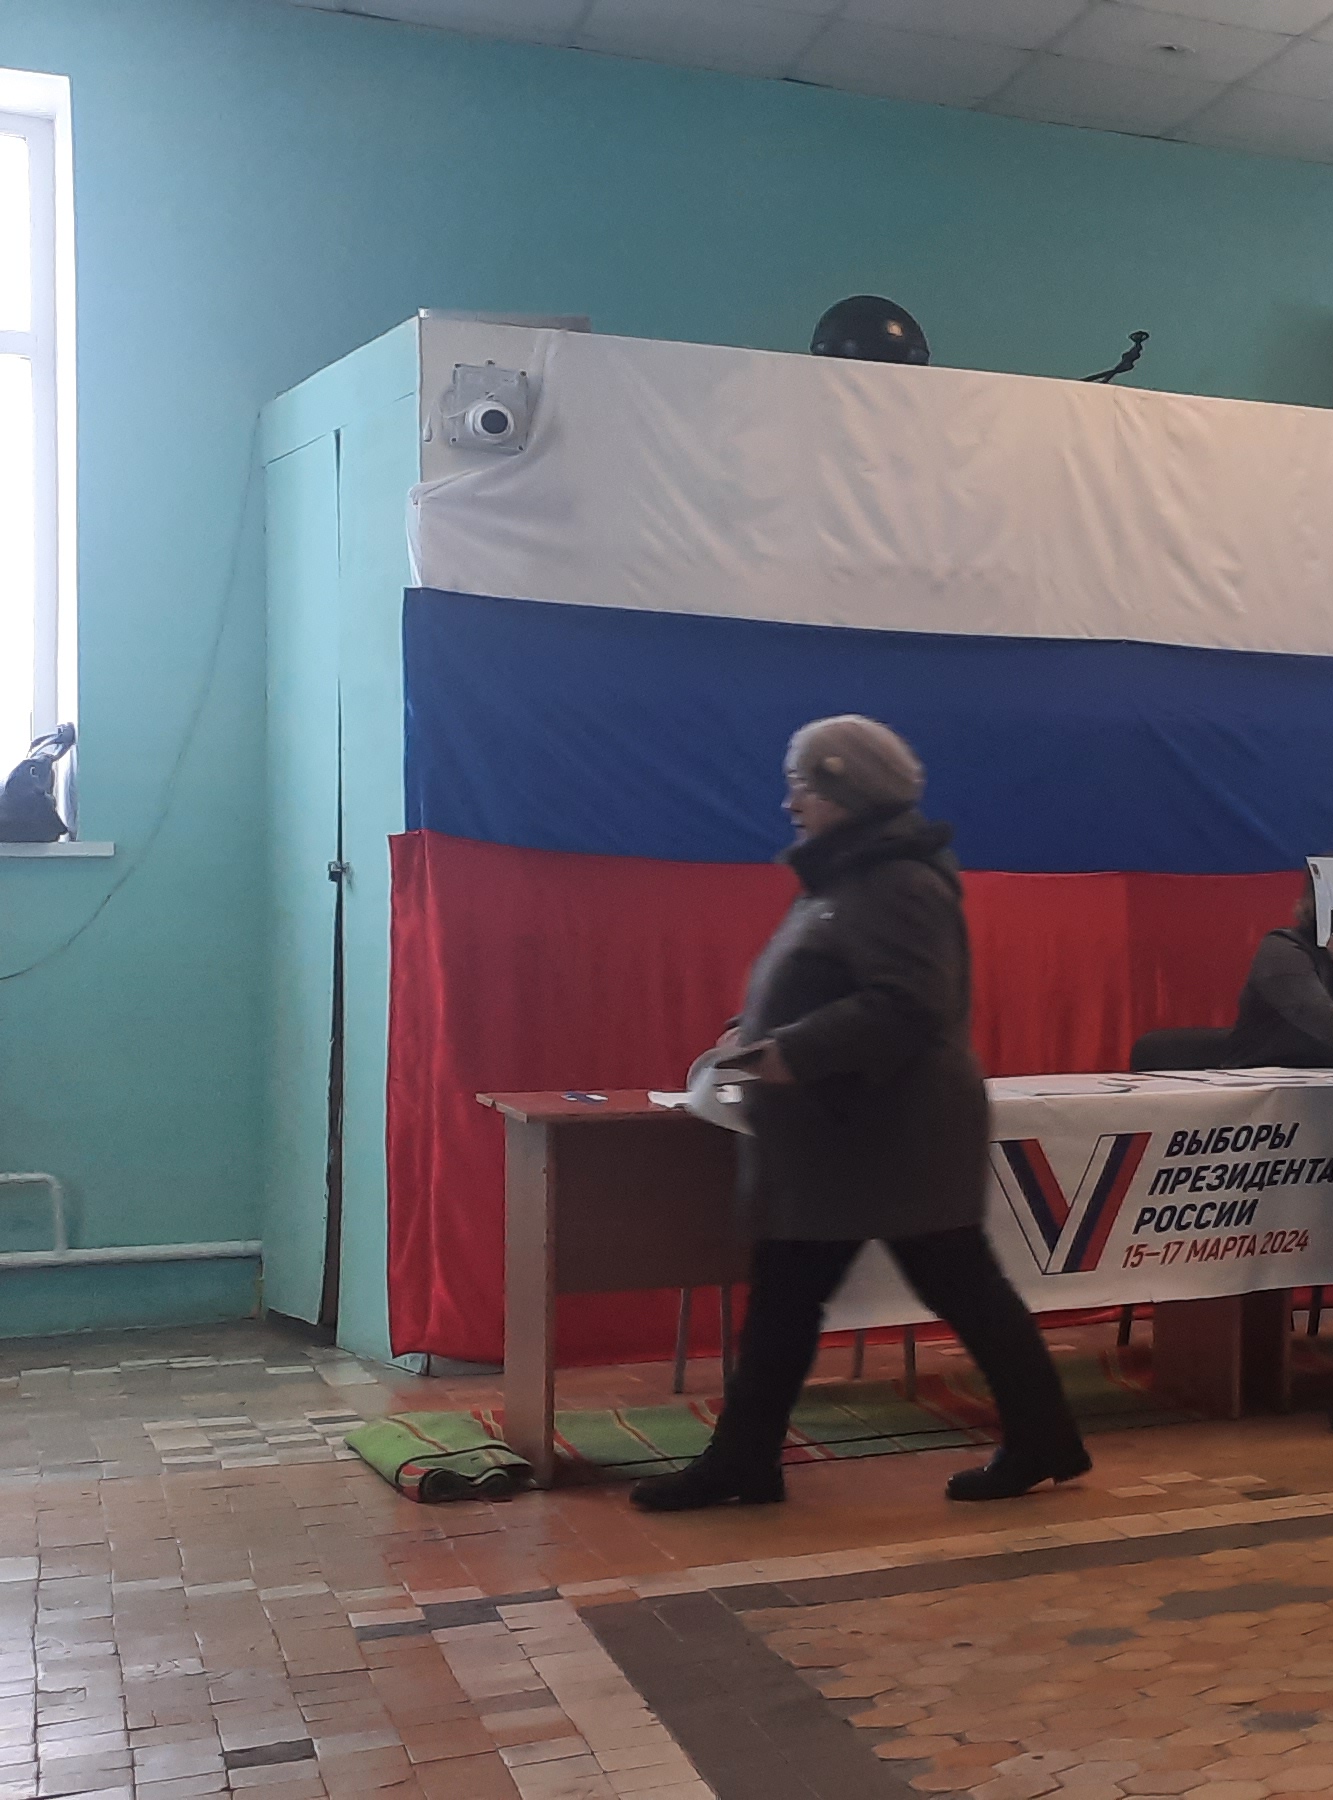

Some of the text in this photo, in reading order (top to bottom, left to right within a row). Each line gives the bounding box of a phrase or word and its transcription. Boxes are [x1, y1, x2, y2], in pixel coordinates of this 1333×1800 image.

[1163, 1122, 1300, 1158] ВЫБОРЫ
[1131, 1198, 1260, 1235] РОССИИ
[1184, 1234, 1258, 1264] МАРТА
[1259, 1229, 1310, 1255] 2024
